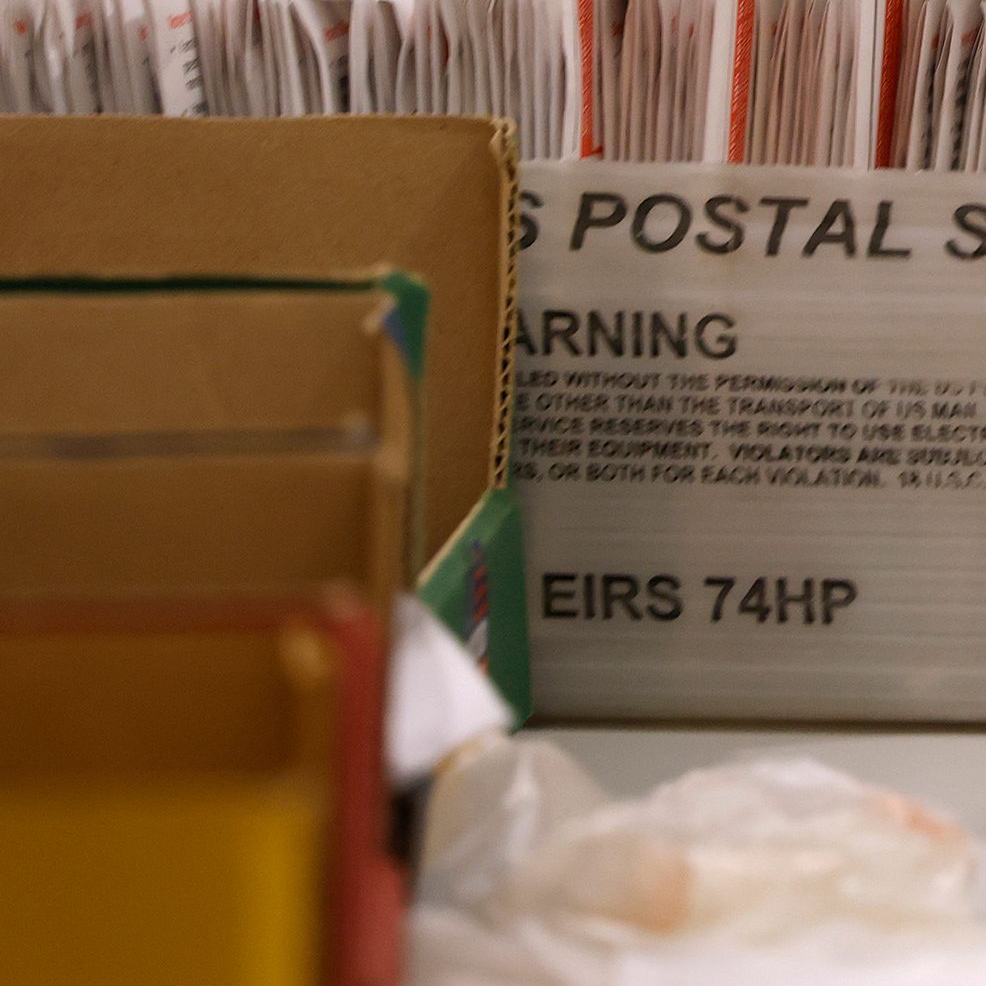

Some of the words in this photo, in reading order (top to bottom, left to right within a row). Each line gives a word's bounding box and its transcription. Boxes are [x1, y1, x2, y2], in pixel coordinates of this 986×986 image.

[519, 190, 544, 251] S
[569, 191, 911, 257] POSTAL
[515, 308, 738, 359] ARNING
[516, 370, 559, 388] LED
[565, 371, 662, 390] WITHOUT
[668, 373, 710, 391] THE
[535, 393, 610, 413] OTHER
[615, 394, 674, 414] THAN
[679, 395, 722, 416] THE
[727, 396, 854, 418] TRANSPORT
[861, 399, 891, 419] OF
[589, 417, 704, 437] RESERVES
[707, 419, 750, 438] THE
[757, 420, 822, 439] RIGHT
[827, 422, 858, 440] TO
[862, 423, 905, 442] USE
[518, 438, 582, 457] THEIR
[729, 442, 850, 463] VIOLATORS
[512, 463, 543, 484] RS,
[548, 463, 580, 482] OR
[586, 464, 646, 483] BOTH
[651, 465, 696, 484] FOR
[702, 465, 761, 485] EACH
[542, 572, 684, 621] EIRS
[703, 575, 858, 625] 74HP
